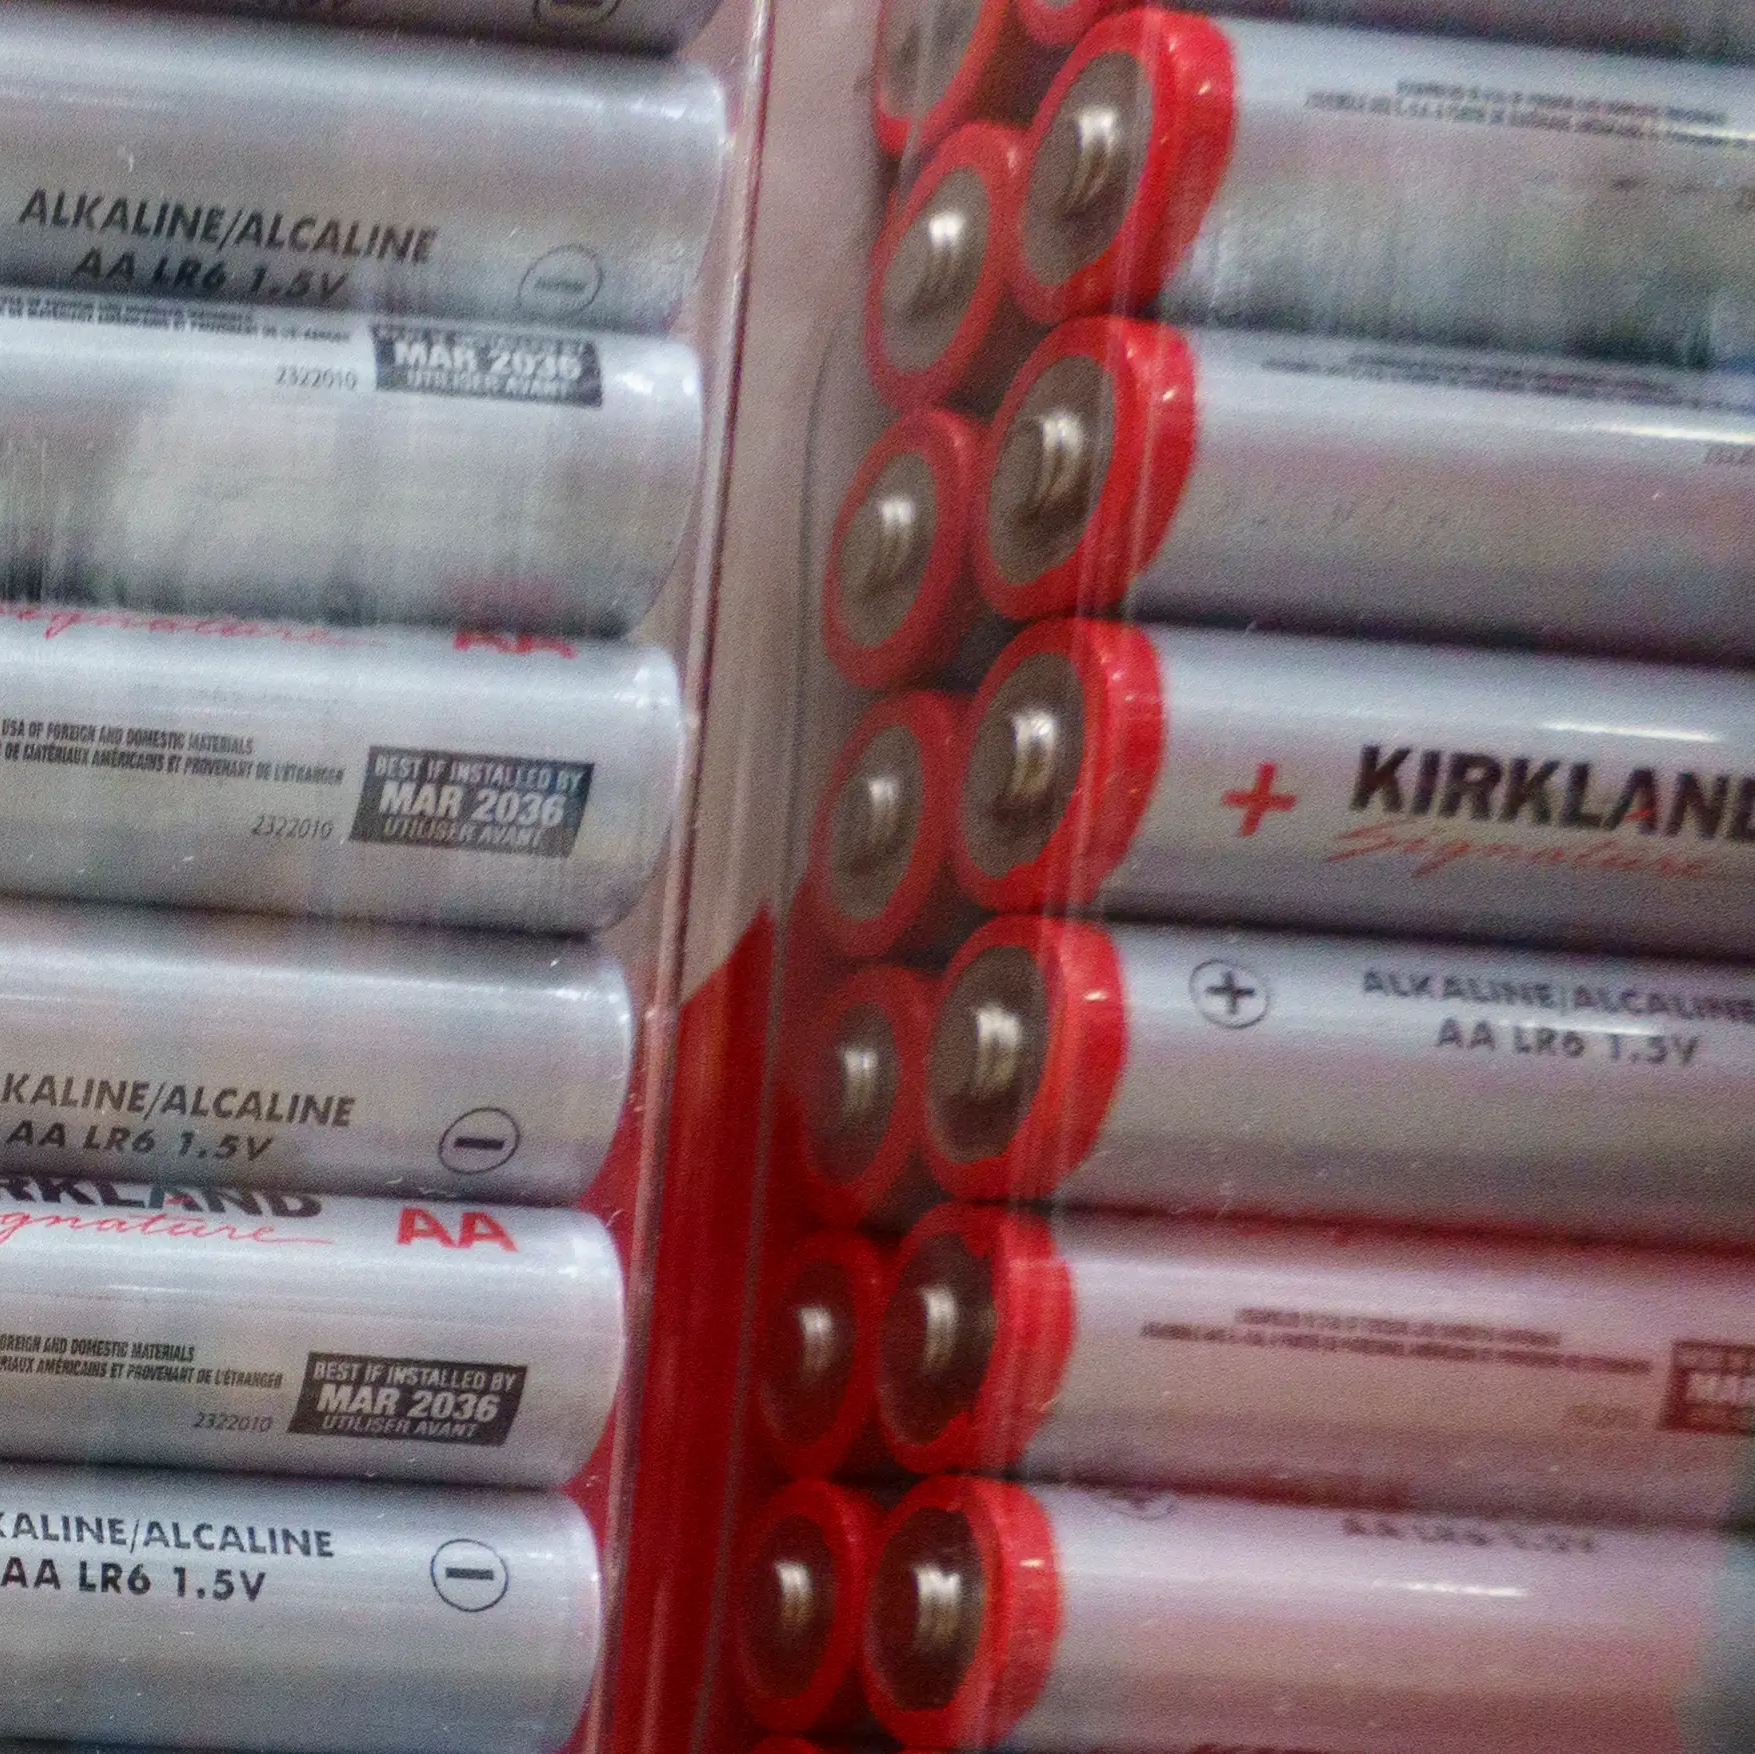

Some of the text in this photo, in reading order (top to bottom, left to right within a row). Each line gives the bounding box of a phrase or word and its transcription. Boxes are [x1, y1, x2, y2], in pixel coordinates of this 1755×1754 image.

[19, 187, 440, 264] ALKALINE/ALCALINE
[72, 246, 349, 301] AA LR6 1.5V
[394, 342, 479, 373] MAR
[375, 753, 584, 794] BEST IF INSTALLED BY
[378, 779, 568, 828] MAR 2036
[251, 814, 334, 840] 2322010
[1436, 1016, 1495, 1049] AA
[1607, 1032, 1701, 1067] 1.5V
[6, 1119, 275, 1163] AA LR6 1.5V
[396, 1207, 519, 1252] AA
[71, 1337, 128, 1360] DOMESTIC
[130, 1341, 194, 1362] MATERIALS
[313, 1360, 517, 1392] BEST IF INSTALLED BY
[192, 1411, 273, 1434] 2322010
[316, 1383, 501, 1423] MAR 2036
[322, 1414, 479, 1438] UTILISER AVANT
[0, 1556, 267, 1601] AA LR6 1.5V
